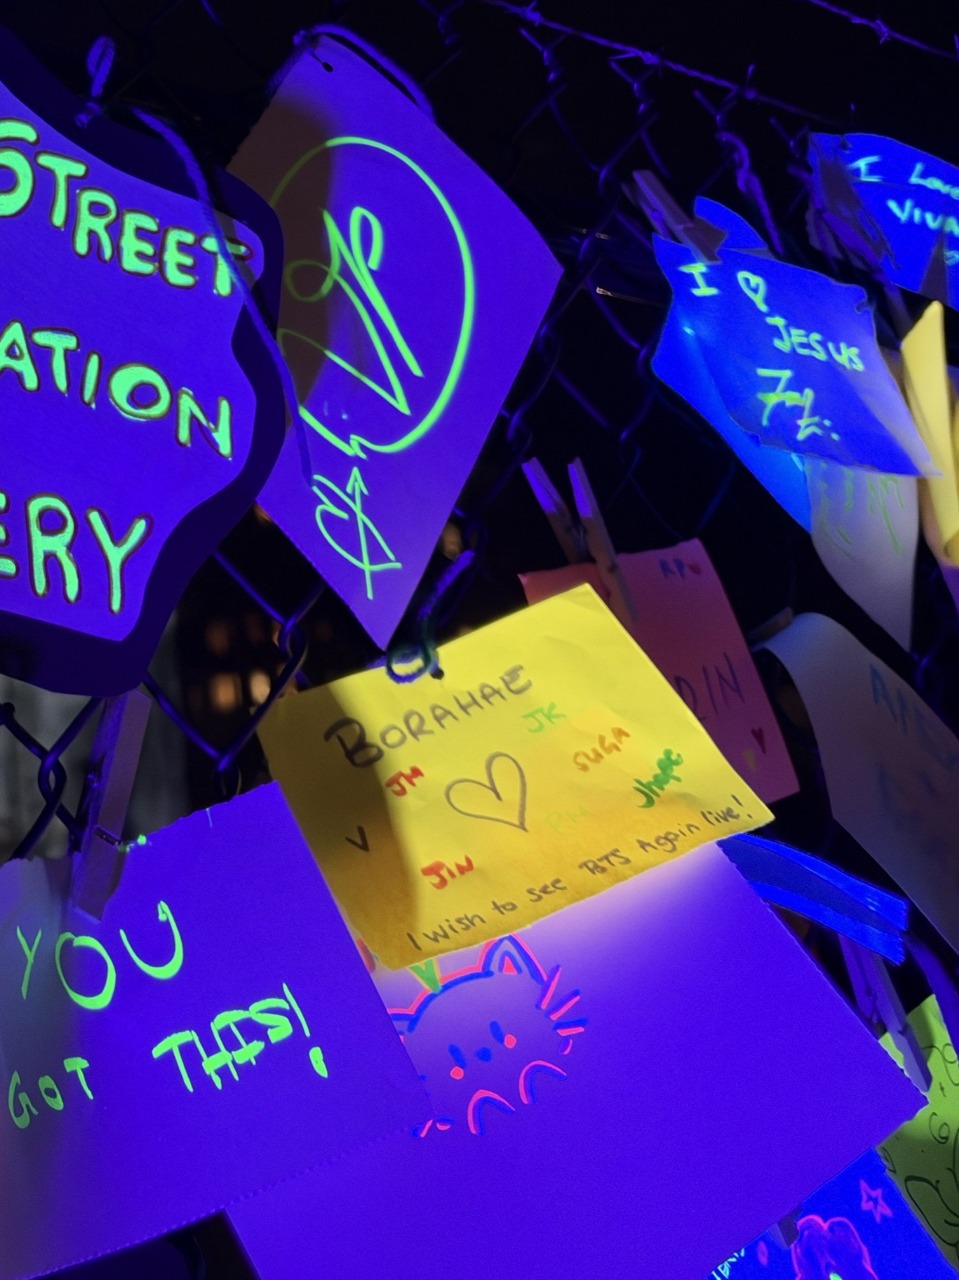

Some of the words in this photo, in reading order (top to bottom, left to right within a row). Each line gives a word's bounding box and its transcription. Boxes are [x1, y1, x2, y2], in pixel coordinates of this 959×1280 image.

[848, 156, 884, 183] I
[678, 261, 719, 298] I
[765, 316, 865, 372] JESUS
[323, 664, 533, 768] BORAHAE
[491, 899, 519, 915] to
[577, 847, 632, 876] BTS
[635, 822, 702, 854] Again
[15, 901, 184, 1011] YOU
[7, 1056, 94, 1130] GOT
[151, 982, 329, 1094] THIS!
